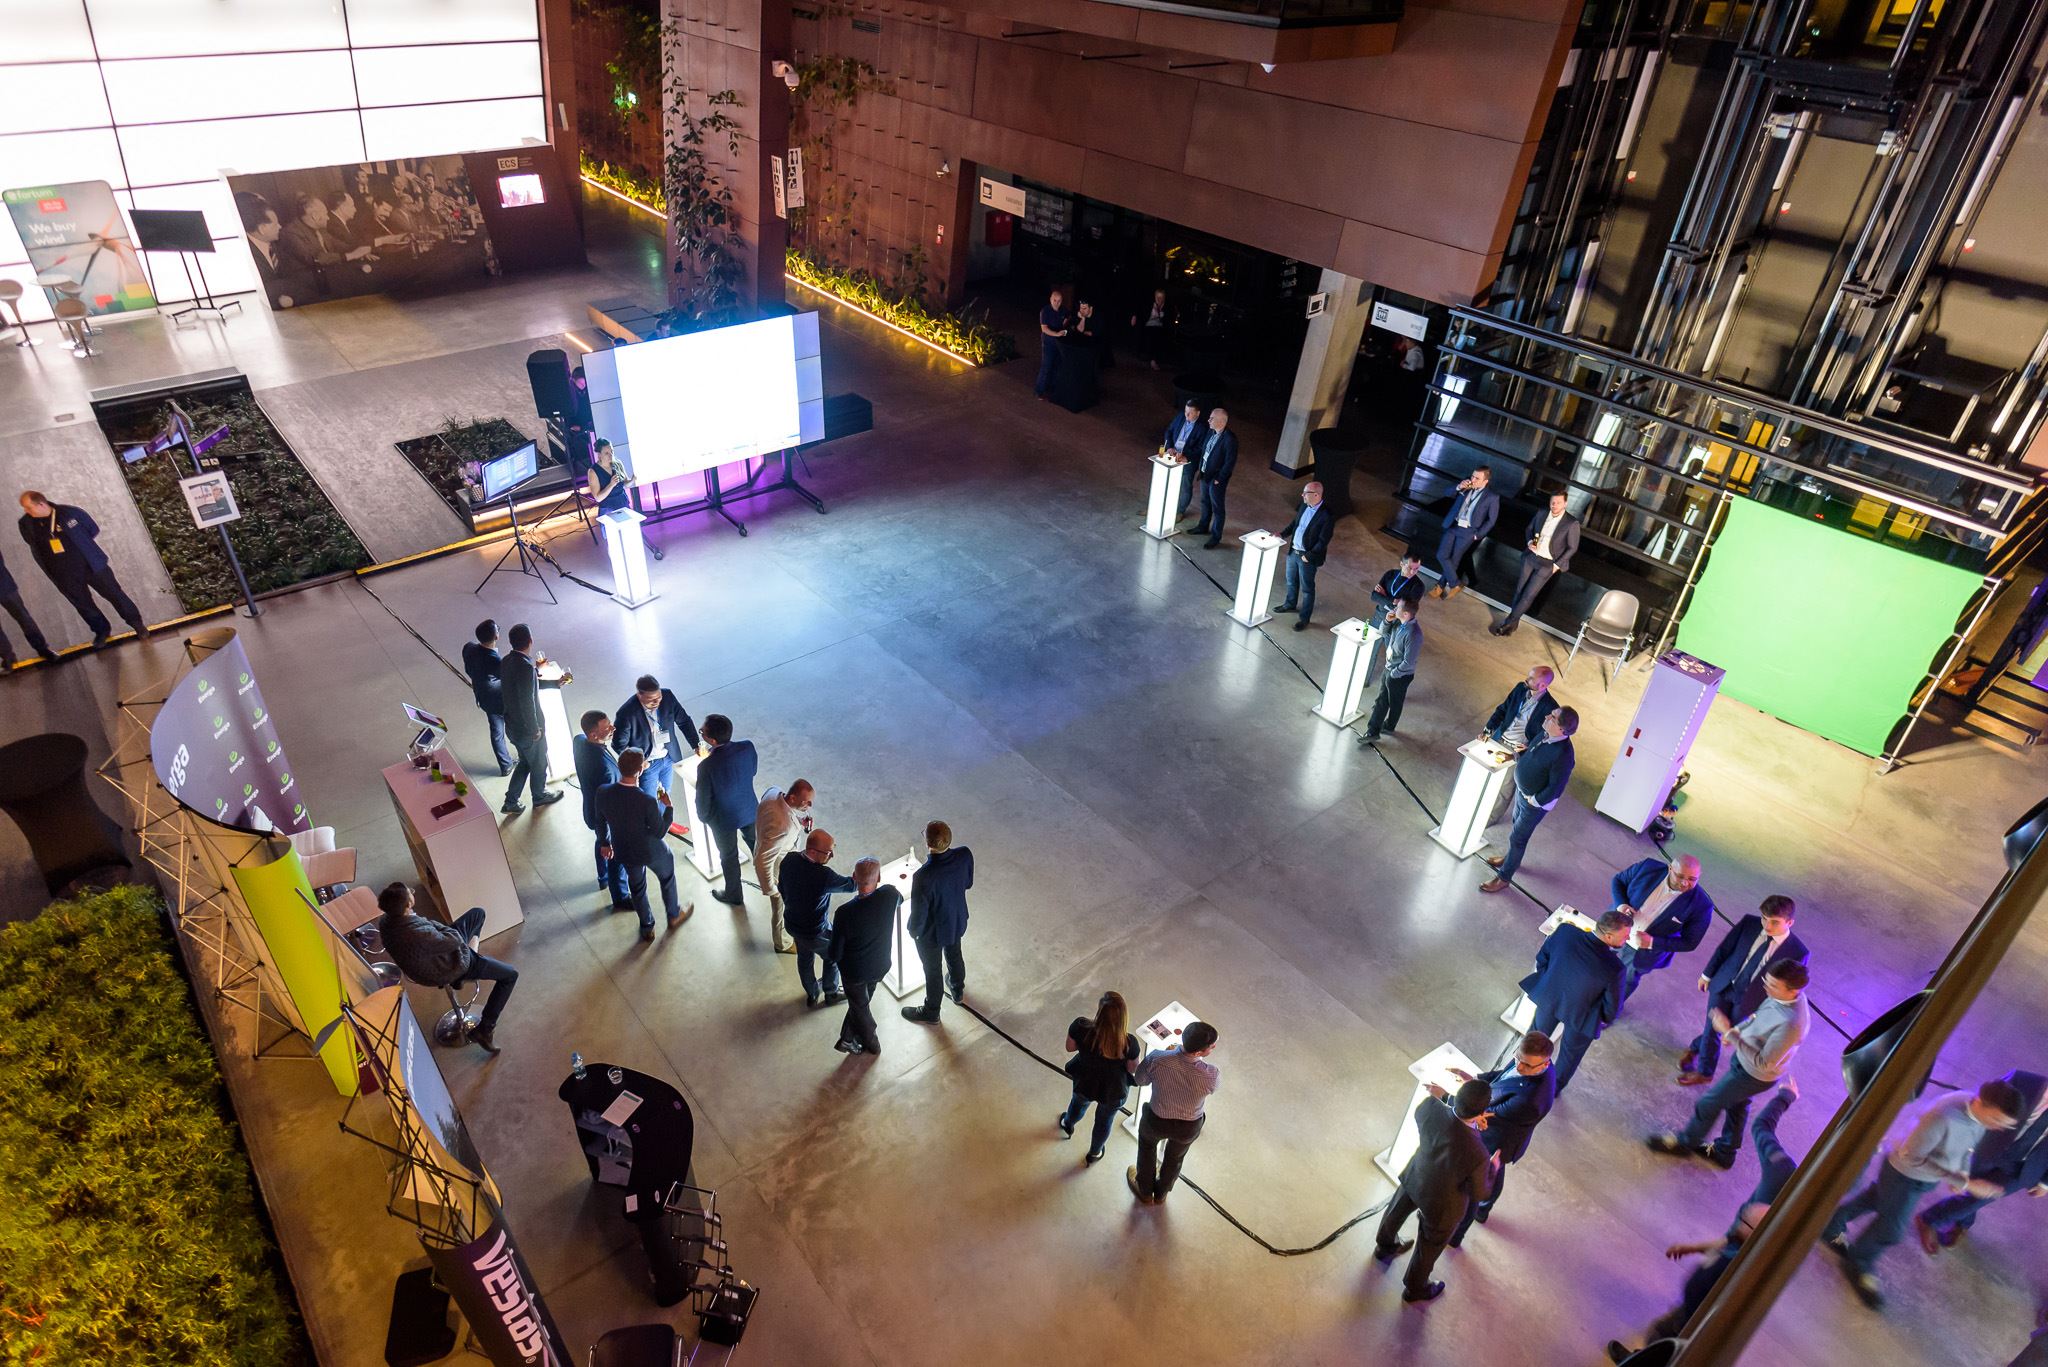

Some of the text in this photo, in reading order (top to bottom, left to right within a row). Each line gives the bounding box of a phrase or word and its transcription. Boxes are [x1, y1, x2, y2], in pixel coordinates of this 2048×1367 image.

[499, 159, 517, 169] ECS
[28, 222, 77, 234] We buy
[34, 233, 66, 246] wind
[473, 1229, 550, 1358] Vestas
